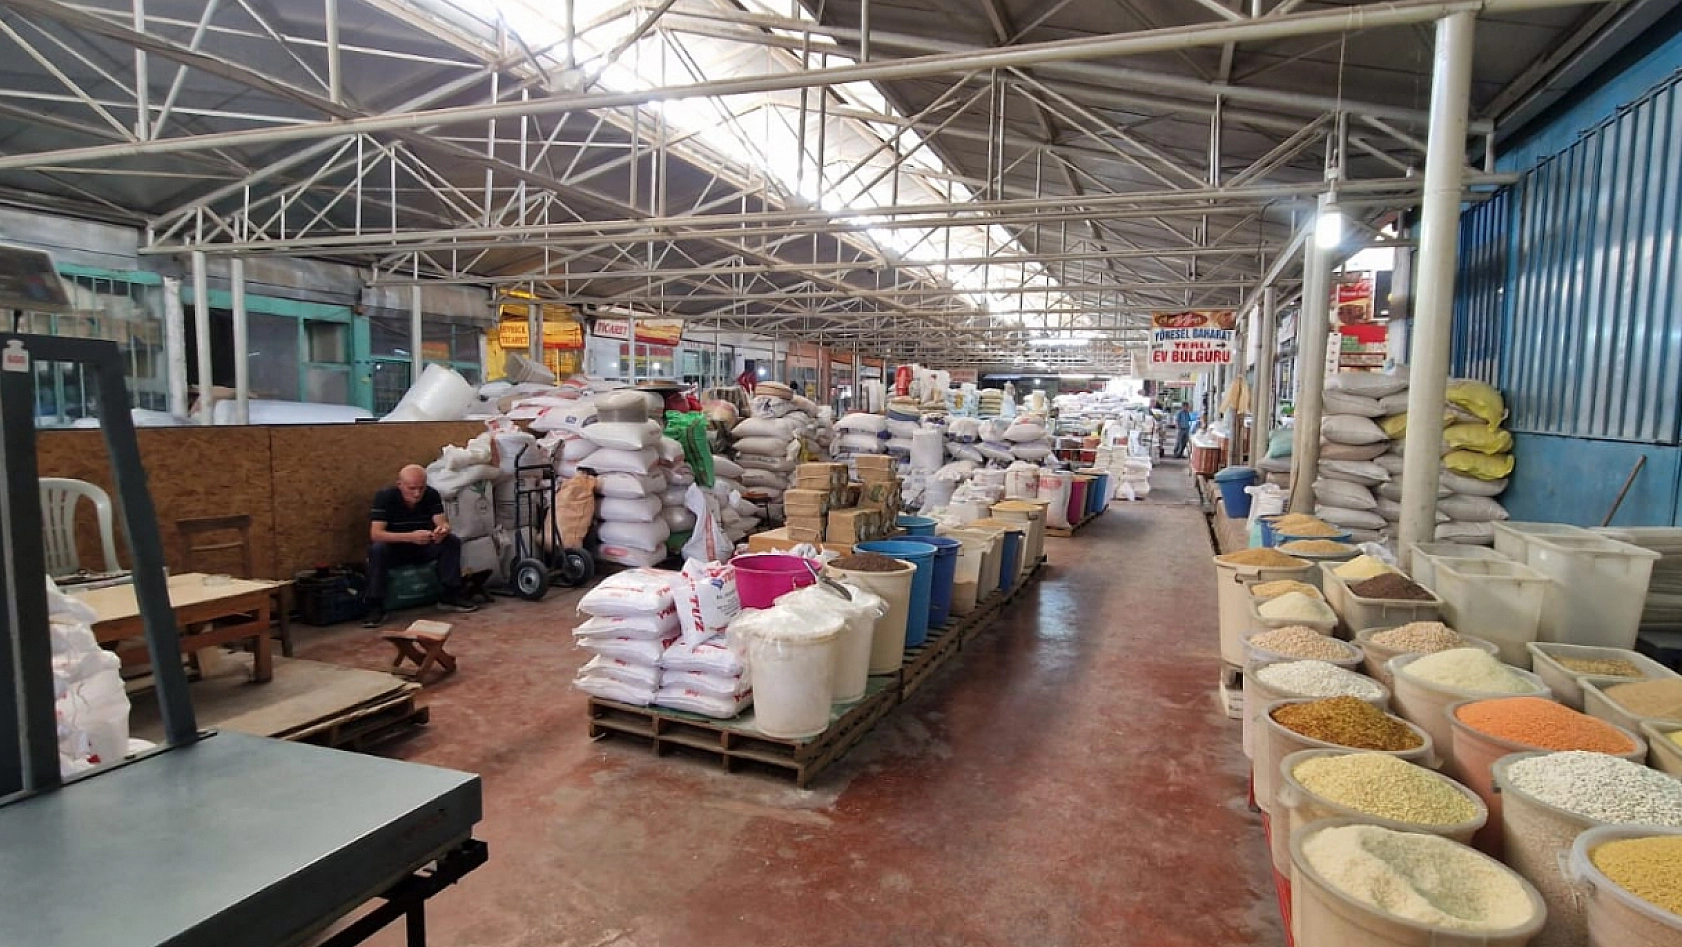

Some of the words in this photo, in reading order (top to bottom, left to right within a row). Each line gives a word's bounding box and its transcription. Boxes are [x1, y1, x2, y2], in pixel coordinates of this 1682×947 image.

[1155, 328, 1189, 341] YÖRESEL
[1193, 328, 1232, 341] BAHARAT
[1153, 350, 1168, 362] EV
[1172, 350, 1230, 362] BULGURU
